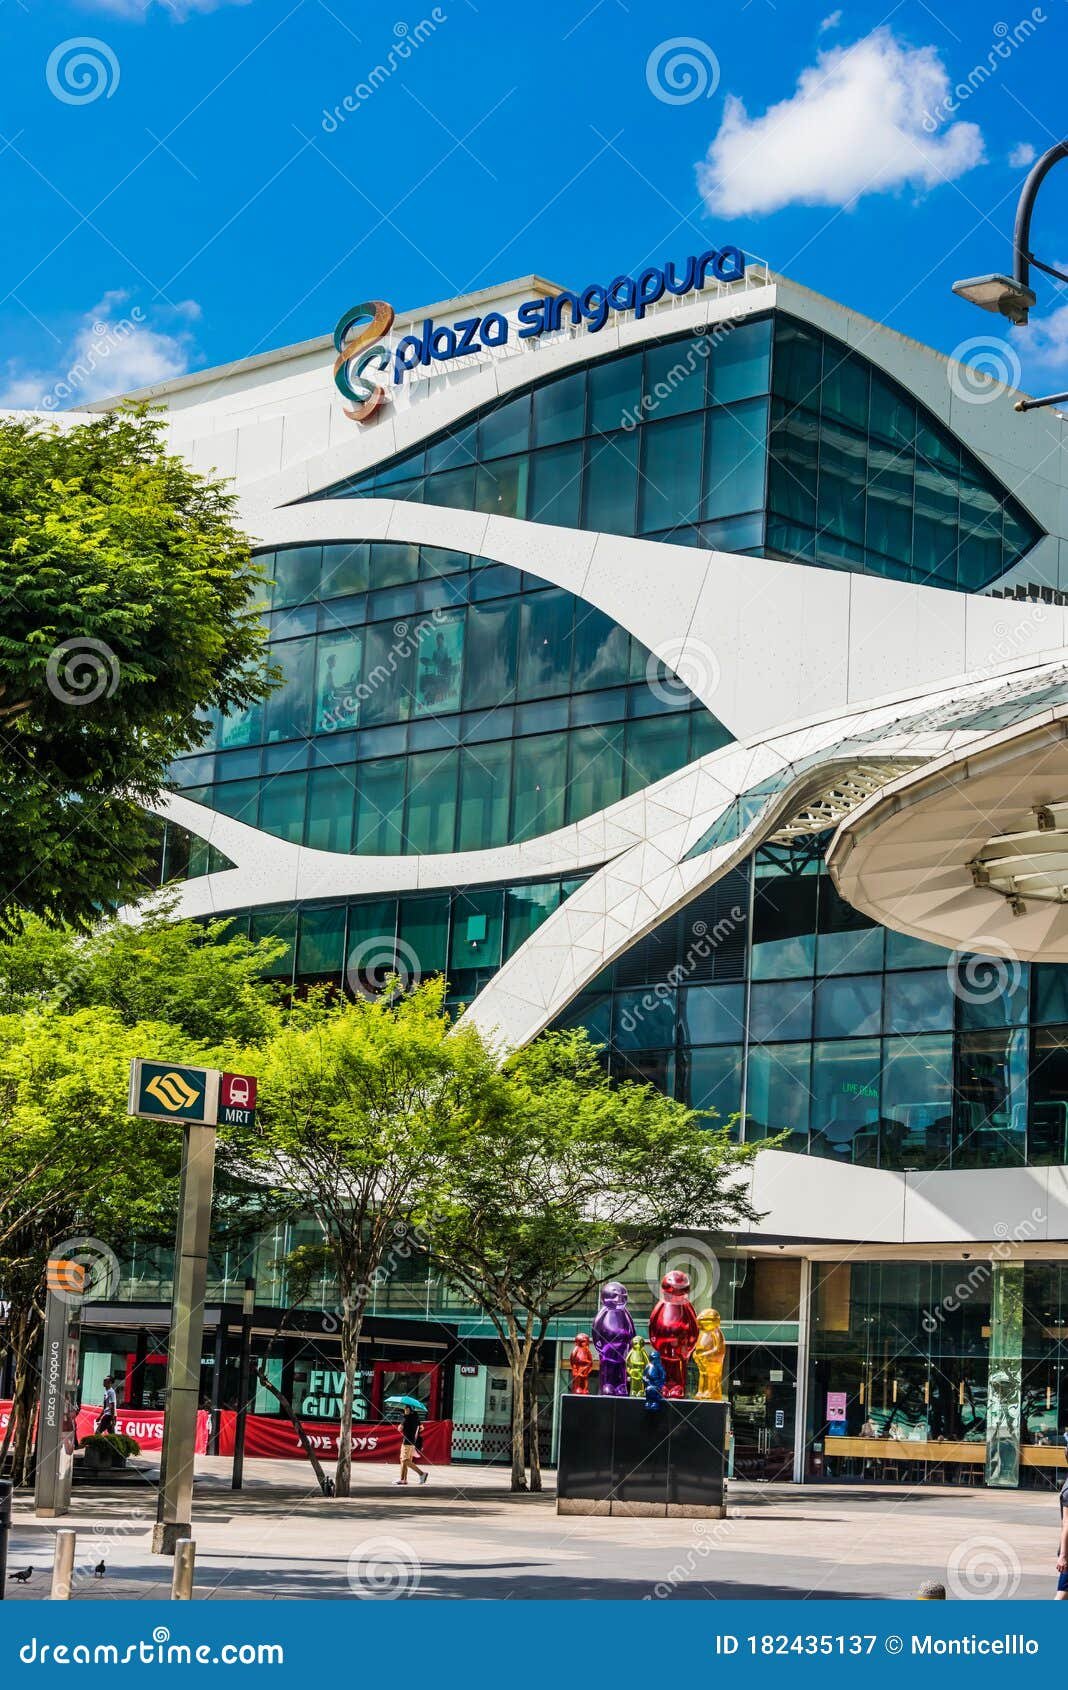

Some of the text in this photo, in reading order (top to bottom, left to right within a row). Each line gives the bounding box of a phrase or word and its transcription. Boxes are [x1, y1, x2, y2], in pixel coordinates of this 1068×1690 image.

[394, 245, 745, 385] plaza singapura
[225, 1108, 251, 1124] MRT
[45, 1341, 60, 1426] plaza singapura
[309, 1370, 362, 1395] FIVE
[126, 1421, 164, 1438] GUYS
